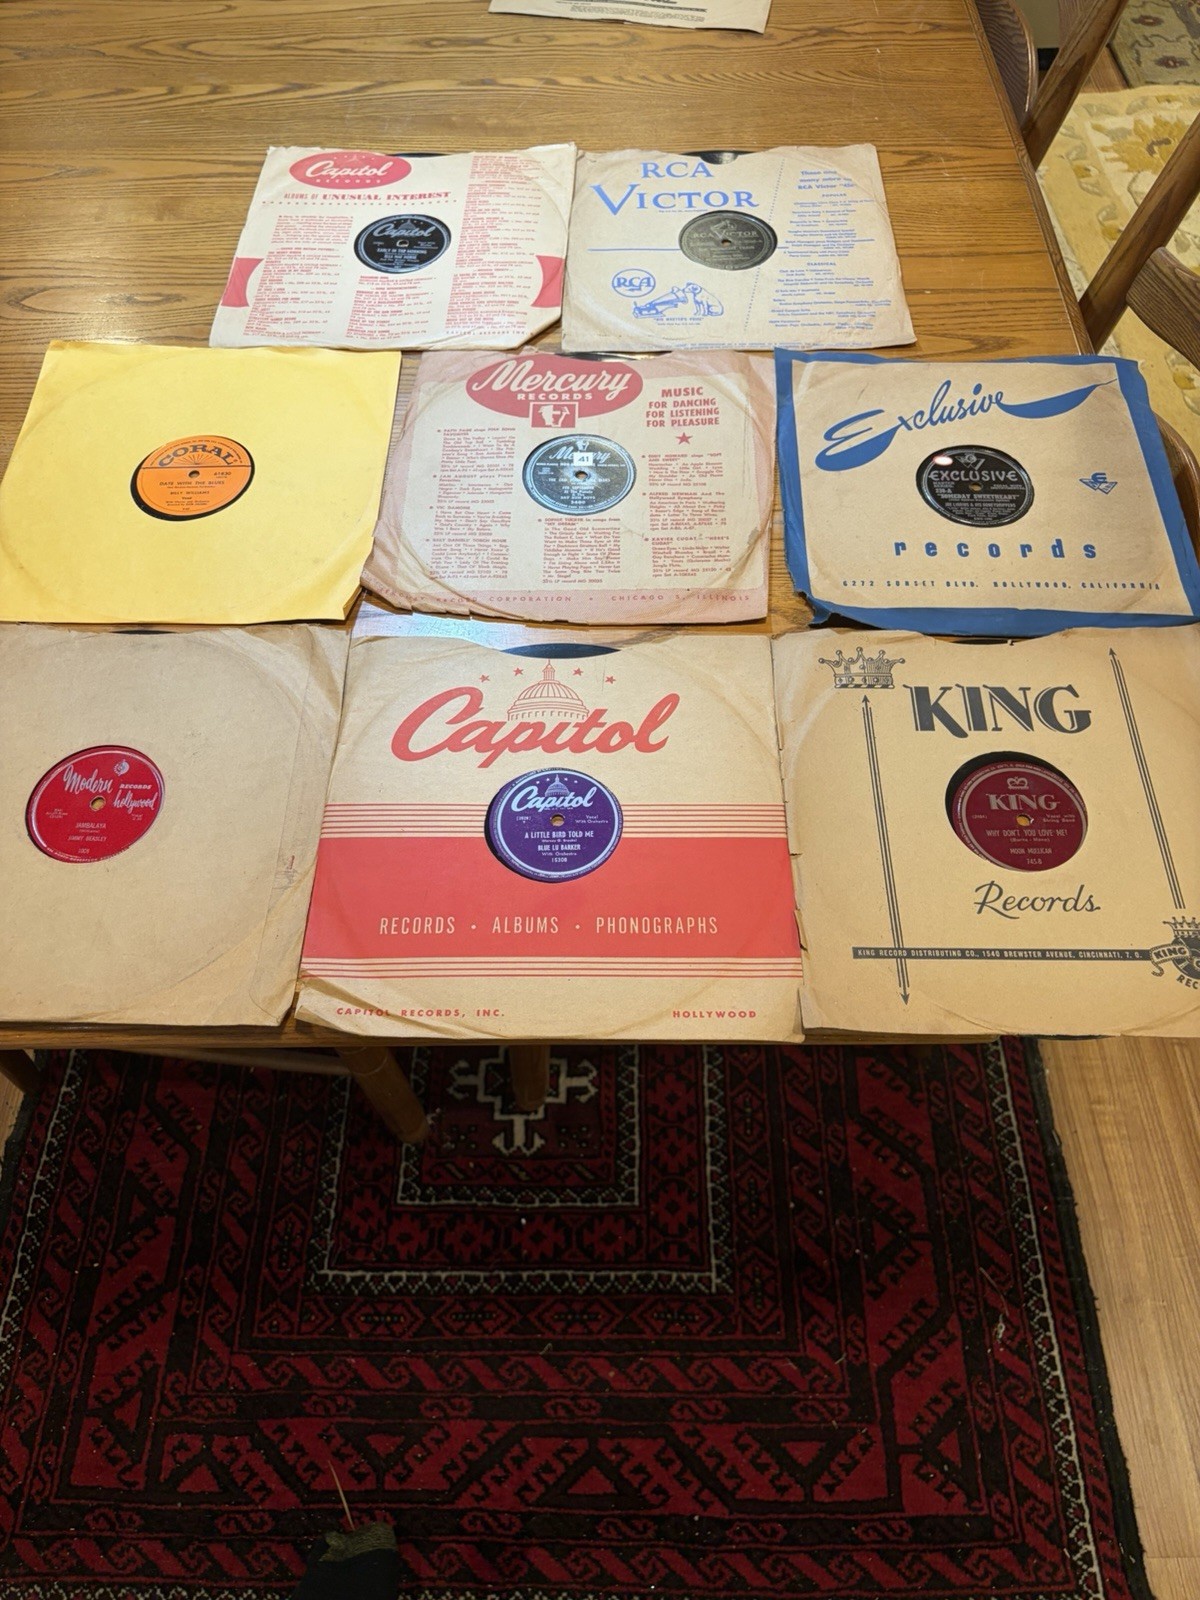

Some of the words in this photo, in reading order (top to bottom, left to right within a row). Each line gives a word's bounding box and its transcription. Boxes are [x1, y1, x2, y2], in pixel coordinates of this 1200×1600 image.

[305, 160, 393, 178] Capitol
[640, 162, 714, 178] RCA
[386, 192, 452, 200] INTEREST
[590, 184, 760, 216] VICTOR
[373, 224, 436, 238] Capitol
[616, 277, 651, 290] RCA
[472, 359, 632, 400] Mercury
[516, 392, 593, 400] RECORDS
[661, 386, 704, 398] MUSIC
[648, 401, 667, 409] FOR
[672, 398, 716, 408] DANCING
[646, 410, 665, 418] FOR
[670, 408, 720, 418] LISTENING
[671, 418, 720, 426] PLEASURE
[814, 379, 1004, 471] Exclusive
[158, 444, 234, 467] CORAL
[928, 470, 1018, 481] EXCLUSIVE
[894, 538, 1097, 558] records
[1081, 582, 1160, 590] CALIFORNIA
[903, 684, 1092, 738] KING
[390, 686, 680, 768] Capitol
[63, 764, 114, 794] Modern
[511, 786, 598, 812] Capitol
[986, 794, 1060, 810] KING
[974, 880, 1101, 920] Records
[379, 917, 456, 935] RECORDS
[492, 916, 560, 934] ALBUMS
[596, 916, 719, 934] PHONOGRAPHS
[1154, 947, 1187, 960] KING
[336, 1007, 391, 1017] CAPITOL
[401, 1008, 466, 1018] RECORDS,
[476, 1009, 505, 1018] INC.
[672, 1010, 758, 1019] HOLLYWOOD
